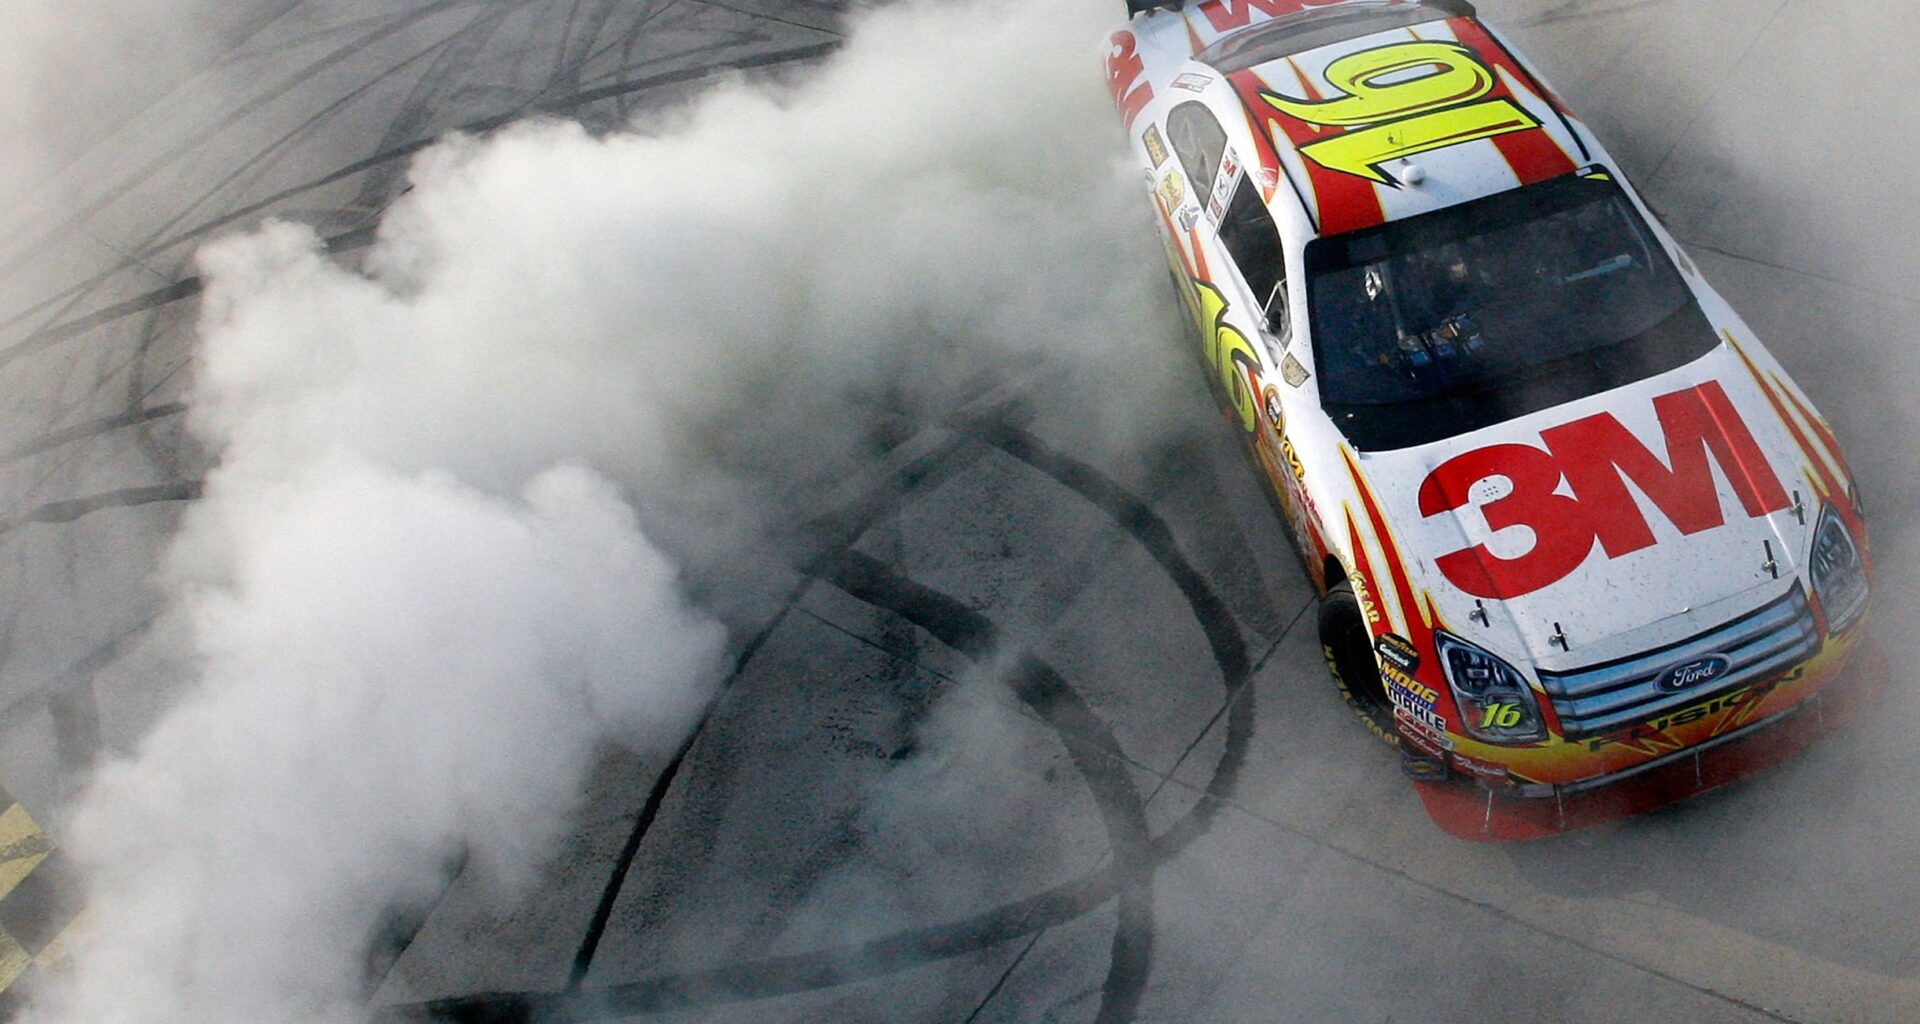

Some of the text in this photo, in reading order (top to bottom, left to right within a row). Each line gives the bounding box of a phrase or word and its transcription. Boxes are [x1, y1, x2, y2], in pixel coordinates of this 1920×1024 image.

[1193, 279, 1264, 433] 16
[1418, 379, 1790, 600] 3M
[1381, 661, 1440, 704] MOOG
[1672, 661, 1715, 688] Ford
[1389, 687, 1446, 732] MAHLE
[1480, 703, 1521, 729] 16
